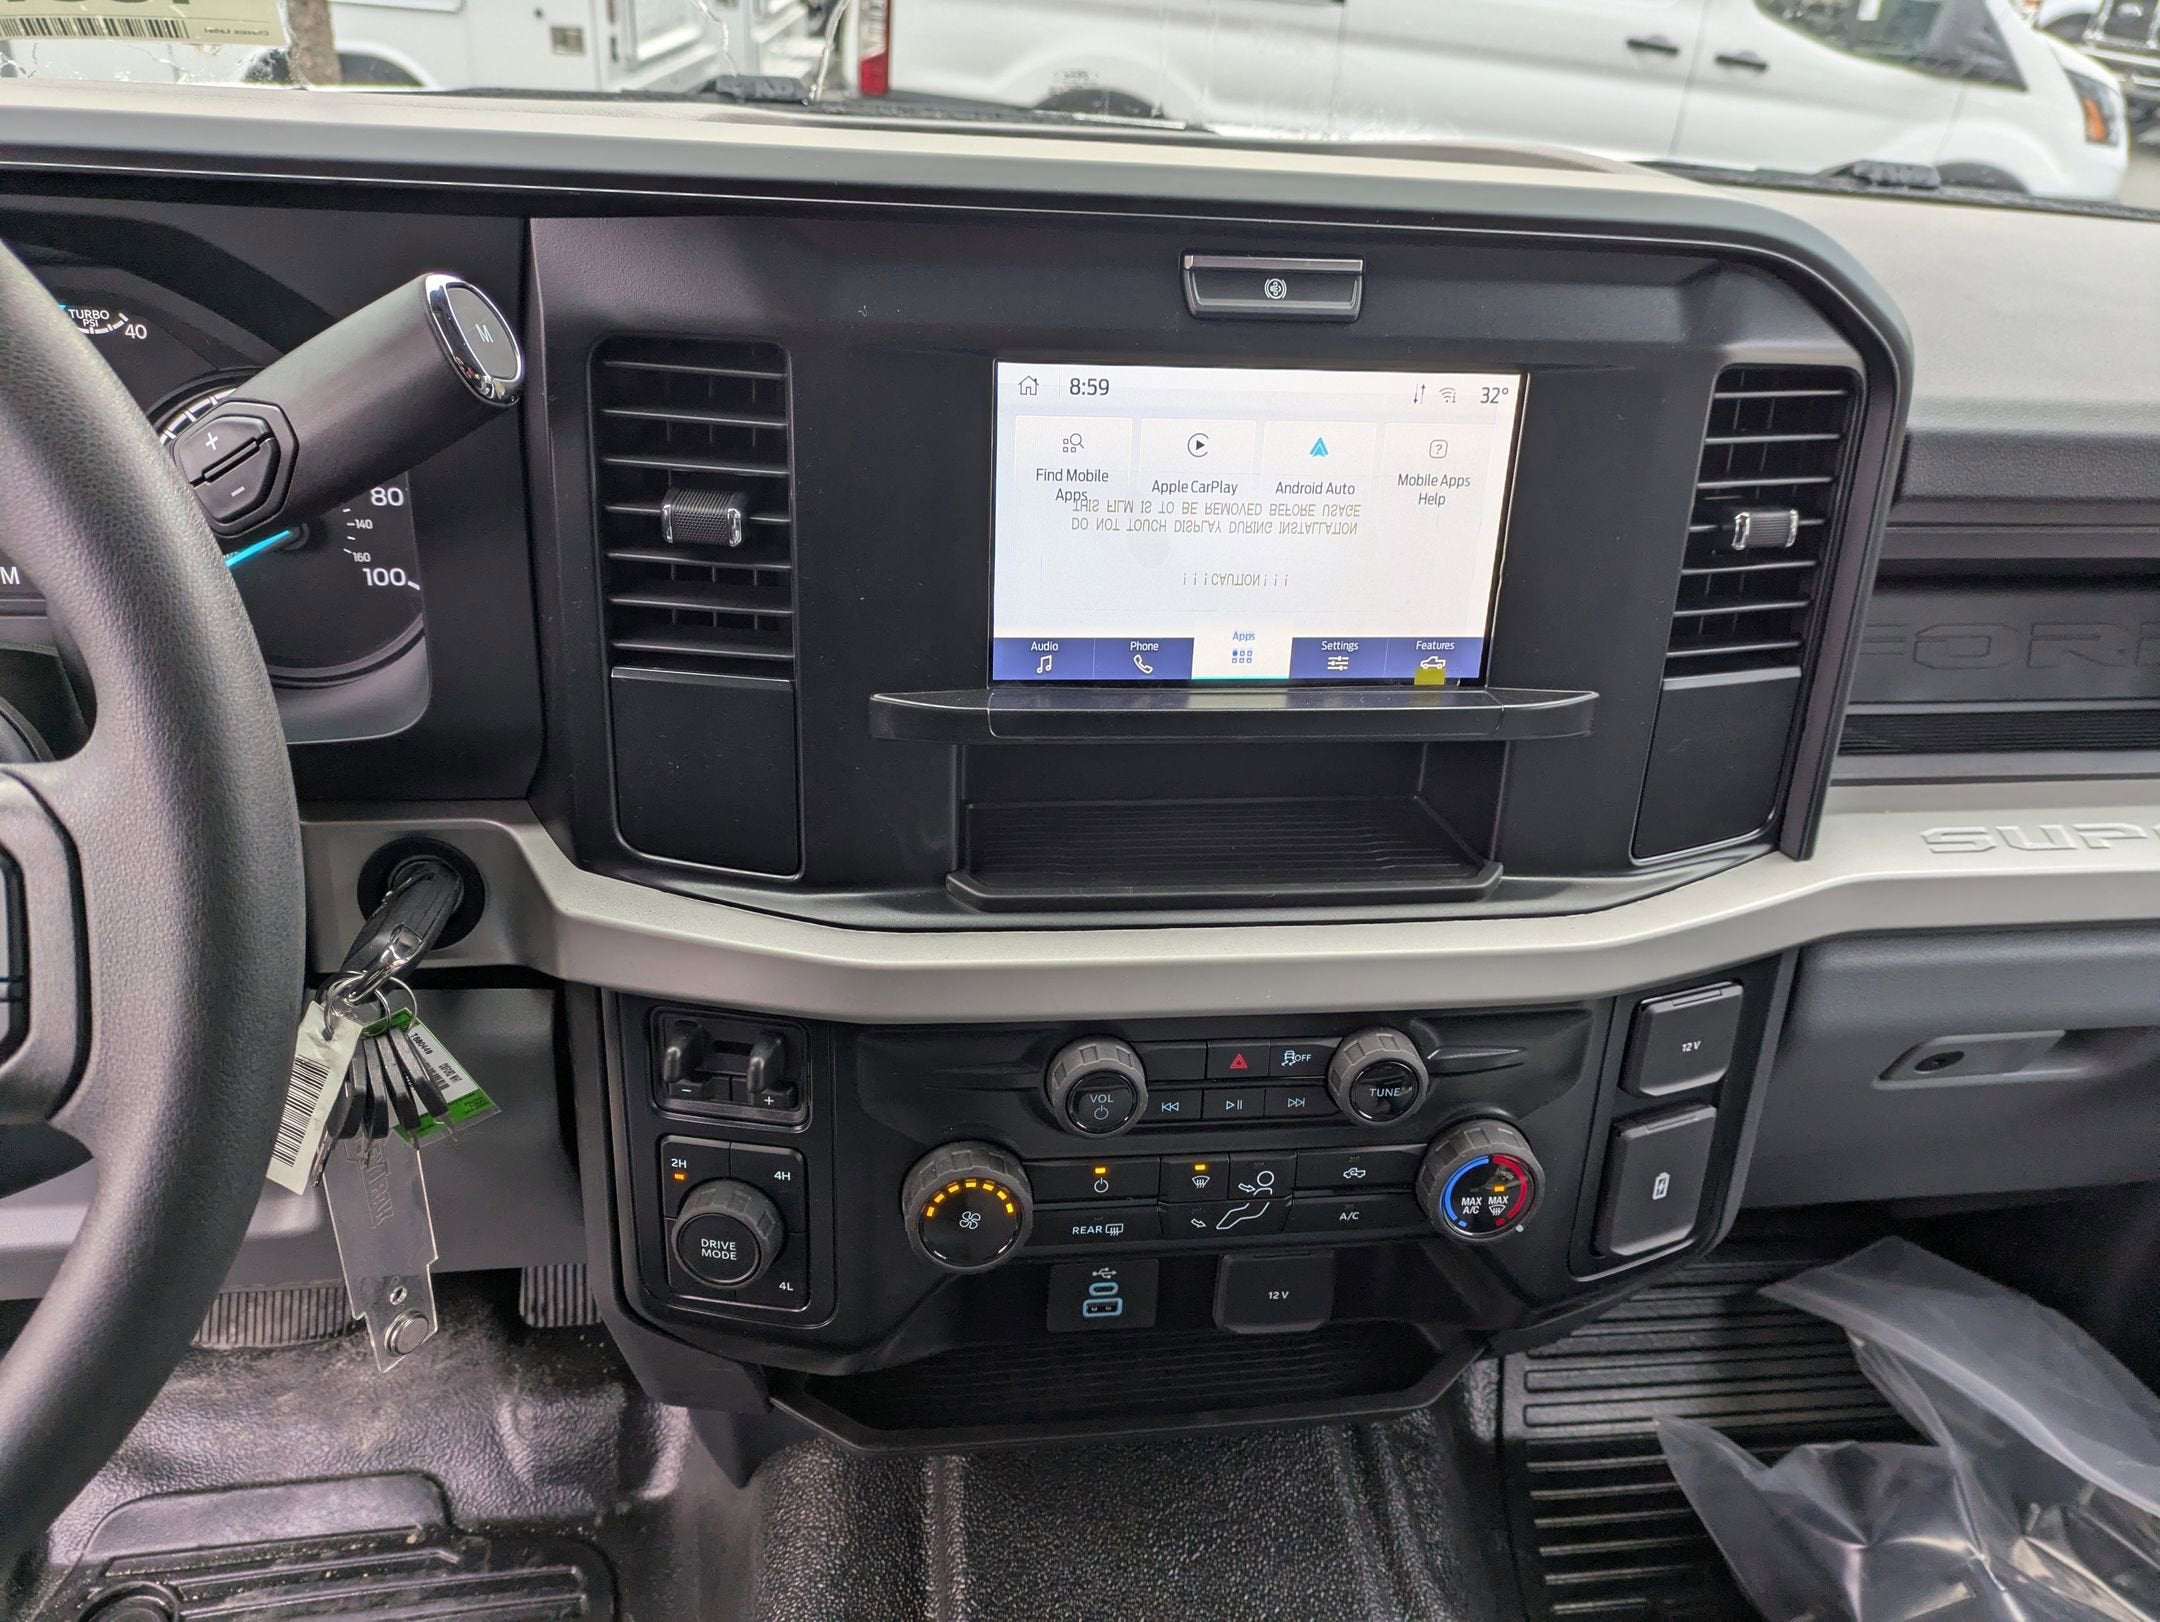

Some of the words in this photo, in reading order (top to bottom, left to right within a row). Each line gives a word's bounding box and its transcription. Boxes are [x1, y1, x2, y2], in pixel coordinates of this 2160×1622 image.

[68, 308, 110, 320] TURBO
[82, 319, 99, 328] PSI
[125, 324, 147, 340] 40
[477, 323, 494, 344] M
[1069, 378, 1110, 396] 8:59
[1480, 387, 1509, 404] 32°
[1036, 468, 1063, 482] Find
[1066, 469, 1109, 483] Mobile
[1398, 474, 1438, 487] Mobile
[1440, 474, 1471, 489] Apps
[1151, 480, 1189, 496] Apple
[1190, 480, 1238, 497] CarPlay
[1275, 481, 1323, 495] Android
[1325, 482, 1356, 495] Auto
[370, 487, 404, 507] 80
[1055, 488, 1088, 504] Apps
[1418, 492, 1446, 508] Help
[355, 519, 373, 530] 140
[352, 552, 371, 563] 160
[0, 566, 20, 585] M
[362, 567, 407, 587] 100
[1232, 631, 1256, 642] Apps
[1030, 641, 1059, 652] Audio
[1130, 641, 1159, 652] Phone
[1321, 640, 1359, 652] Settings
[1416, 640, 1455, 651] Features
[1920, 822, 2160, 854] SUP
[1681, 1042, 1693, 1053] 12
[1294, 1053, 1312, 1063] OFF
[1369, 1087, 1401, 1097] TUNE
[1089, 1094, 1114, 1104] VOL
[671, 1158, 687, 1169] 2H
[774, 1171, 791, 1181] 4H
[1461, 1197, 1482, 1207] MAX
[1488, 1195, 1509, 1205] MAX
[1462, 1205, 1480, 1215] A/C
[1339, 1210, 1360, 1222] A/C
[1072, 1225, 1103, 1236] REAR
[701, 1238, 736, 1251] DRIVE
[701, 1249, 737, 1261] MODE
[778, 1281, 793, 1291] 4L
[1268, 1291, 1280, 1300] 12
[1281, 1290, 1289, 1299] V
